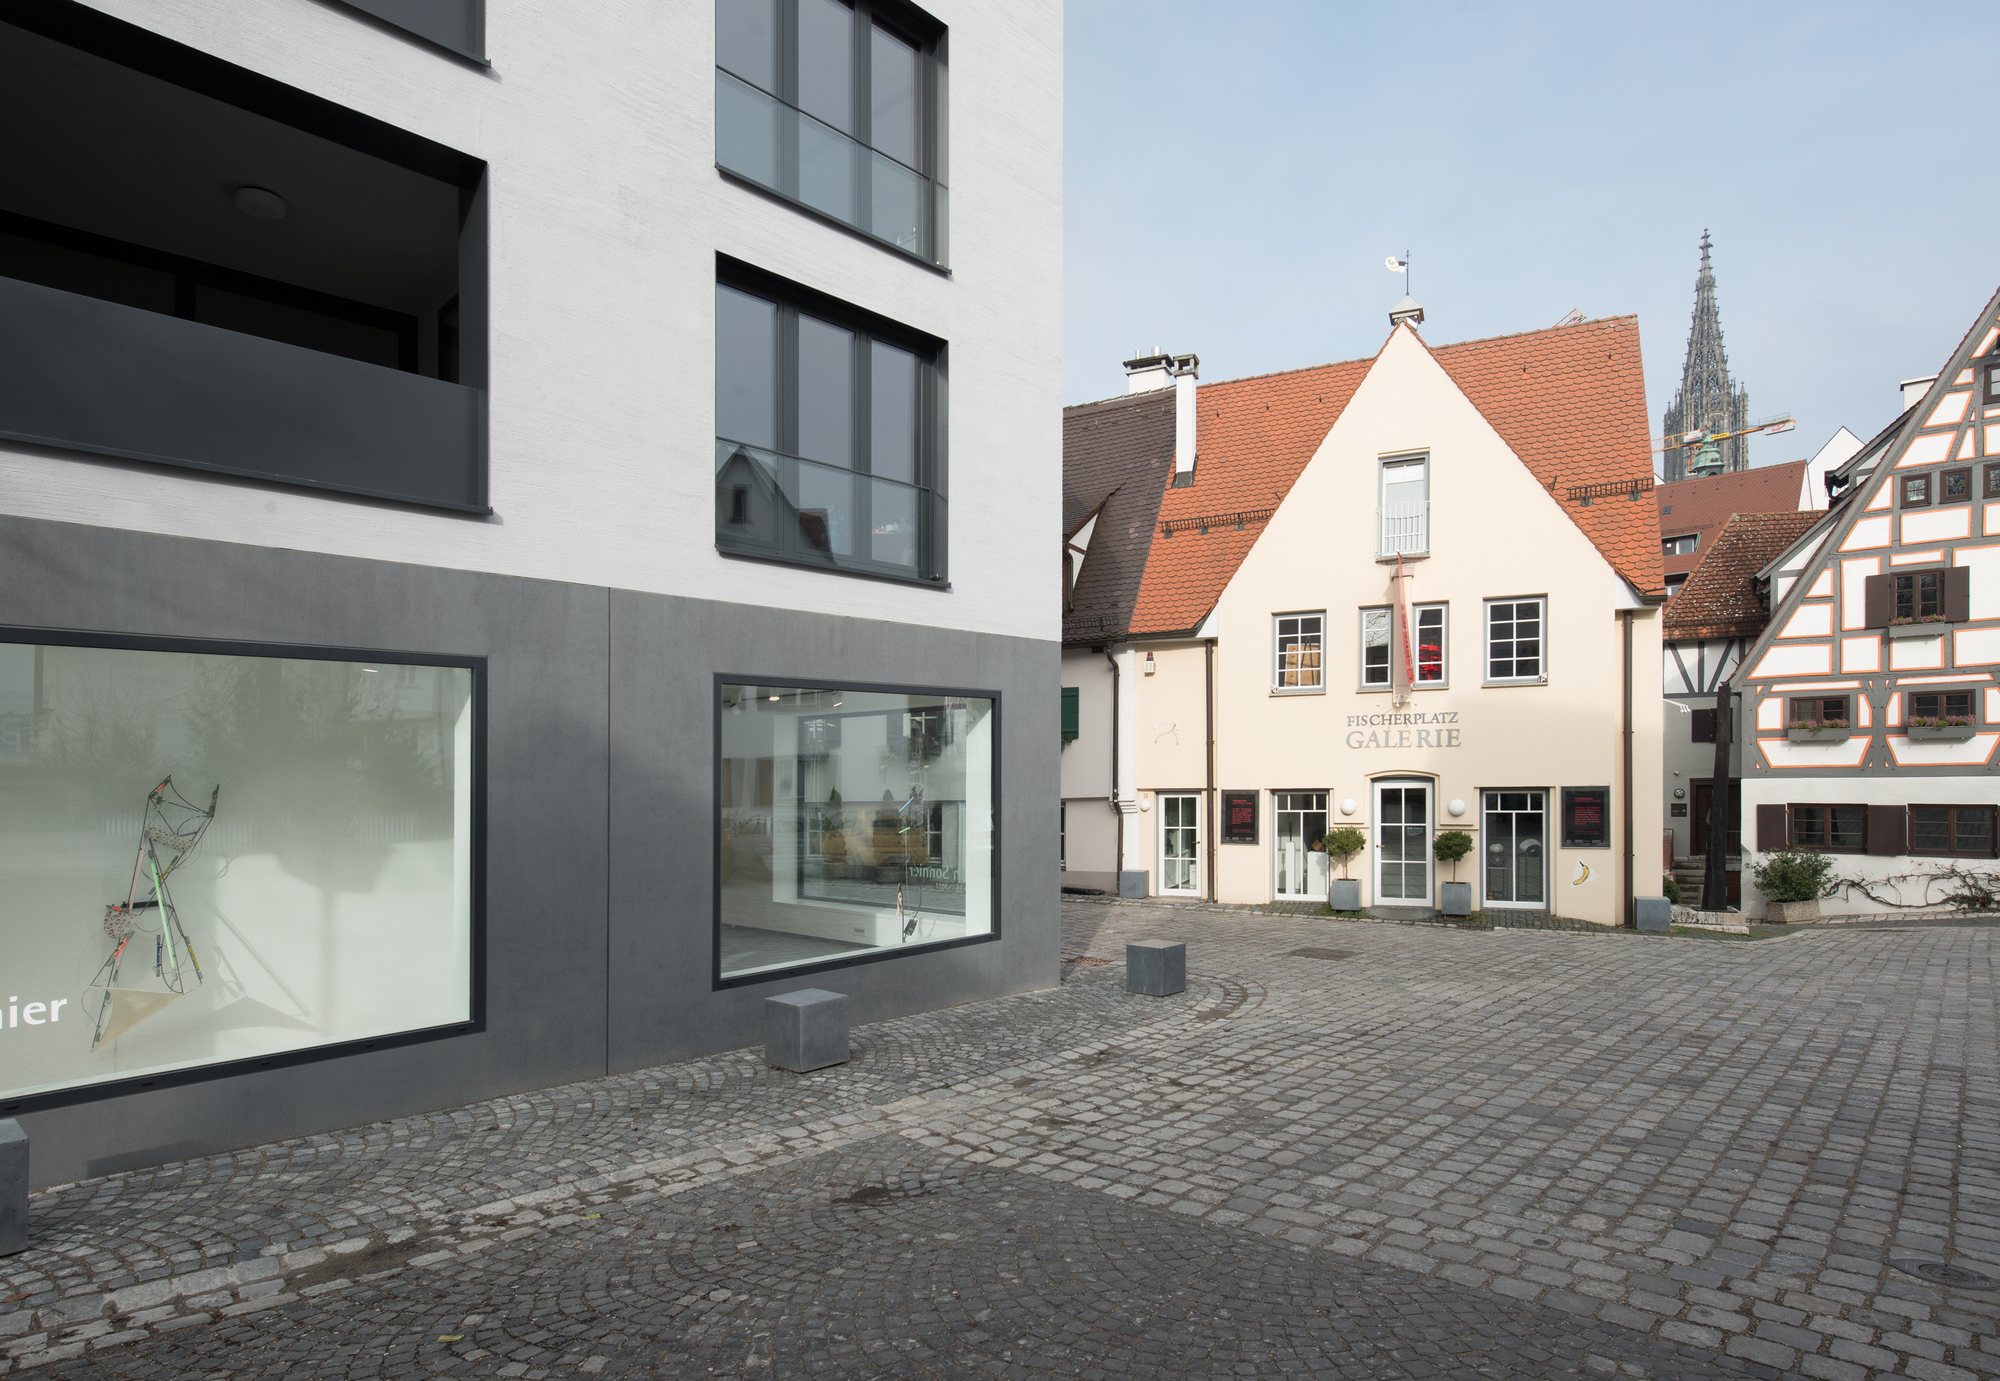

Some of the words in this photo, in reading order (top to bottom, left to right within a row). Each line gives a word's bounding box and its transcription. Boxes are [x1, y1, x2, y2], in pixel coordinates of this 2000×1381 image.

[1346, 711, 1459, 727] FISCHERPLATZ
[1345, 728, 1462, 750] GALERIE
[0, 995, 68, 1030] ier
